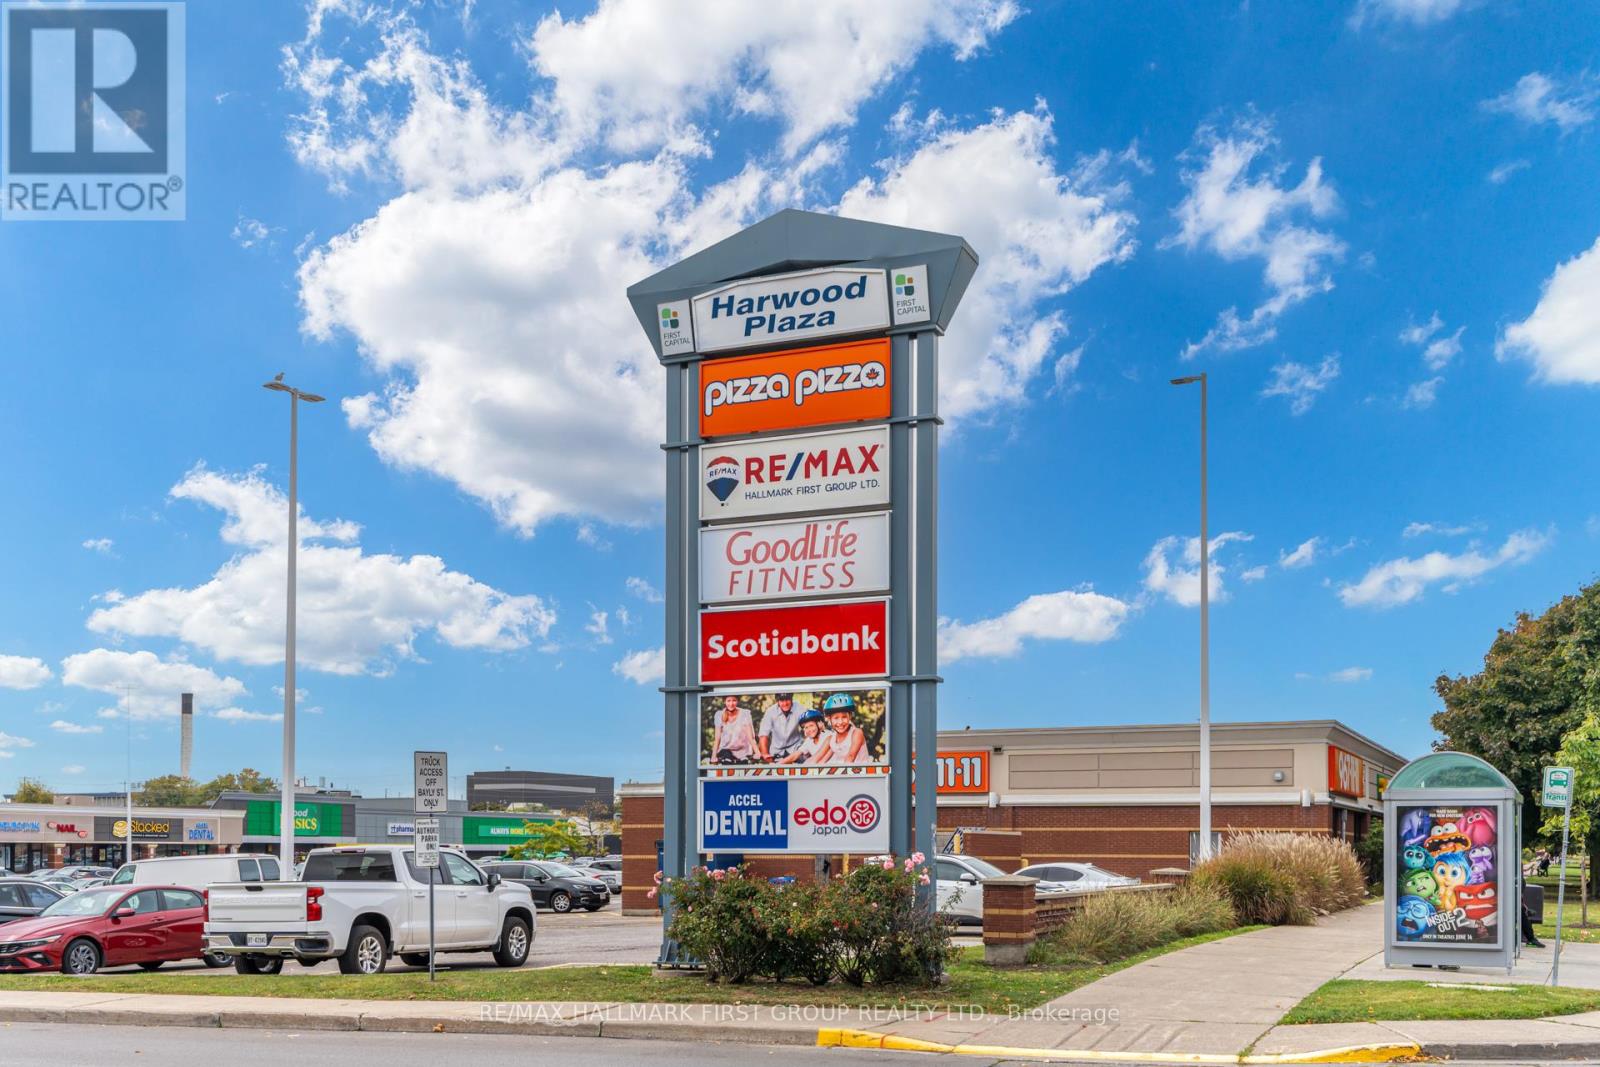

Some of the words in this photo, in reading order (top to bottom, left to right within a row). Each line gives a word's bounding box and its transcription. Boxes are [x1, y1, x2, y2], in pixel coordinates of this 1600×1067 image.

[711, 275, 867, 319] Harwood
[896, 298, 916, 308] FIRST
[897, 304, 927, 316] CAPITAL
[743, 309, 836, 337] Plaza
[663, 331, 681, 339] FIRST
[664, 336, 691, 347] CAPITAL
[704, 373, 790, 417] pizza
[794, 361, 886, 407] pizza
[745, 444, 880, 485] RE/MAX
[709, 468, 737, 478] RE/MAX
[745, 488, 793, 500] HALLMARK
[796, 485, 821, 495] FIRST
[825, 482, 857, 492] GROUP
[861, 479, 880, 489] LTD.
[726, 520, 858, 566] GoodLife
[729, 561, 855, 595] FITNESS
[708, 625, 880, 659] Scotiabank
[420, 757, 441, 767] TRUCK
[419, 768, 443, 777] ACCESS
[425, 778, 437, 787] OFF
[418, 788, 435, 797] BAYLY
[436, 788, 445, 797] ST.
[423, 798, 439, 807] ONLY
[728, 794, 763, 806] ACCEL
[294, 808, 309, 817] ood
[793, 799, 847, 826] edo
[131, 819, 170, 833] Stacked
[294, 817, 318, 831] SICS
[396, 824, 415, 834] pharma
[704, 810, 787, 836] DENTAL
[188, 829, 215, 841] DENTAL
[490, 827, 510, 835] ALWAYS
[812, 825, 847, 836] japan
[1425, 911, 1456, 928] INSIDE
[1453, 907, 1470, 928] 2
[1438, 918, 1457, 933] OUT
